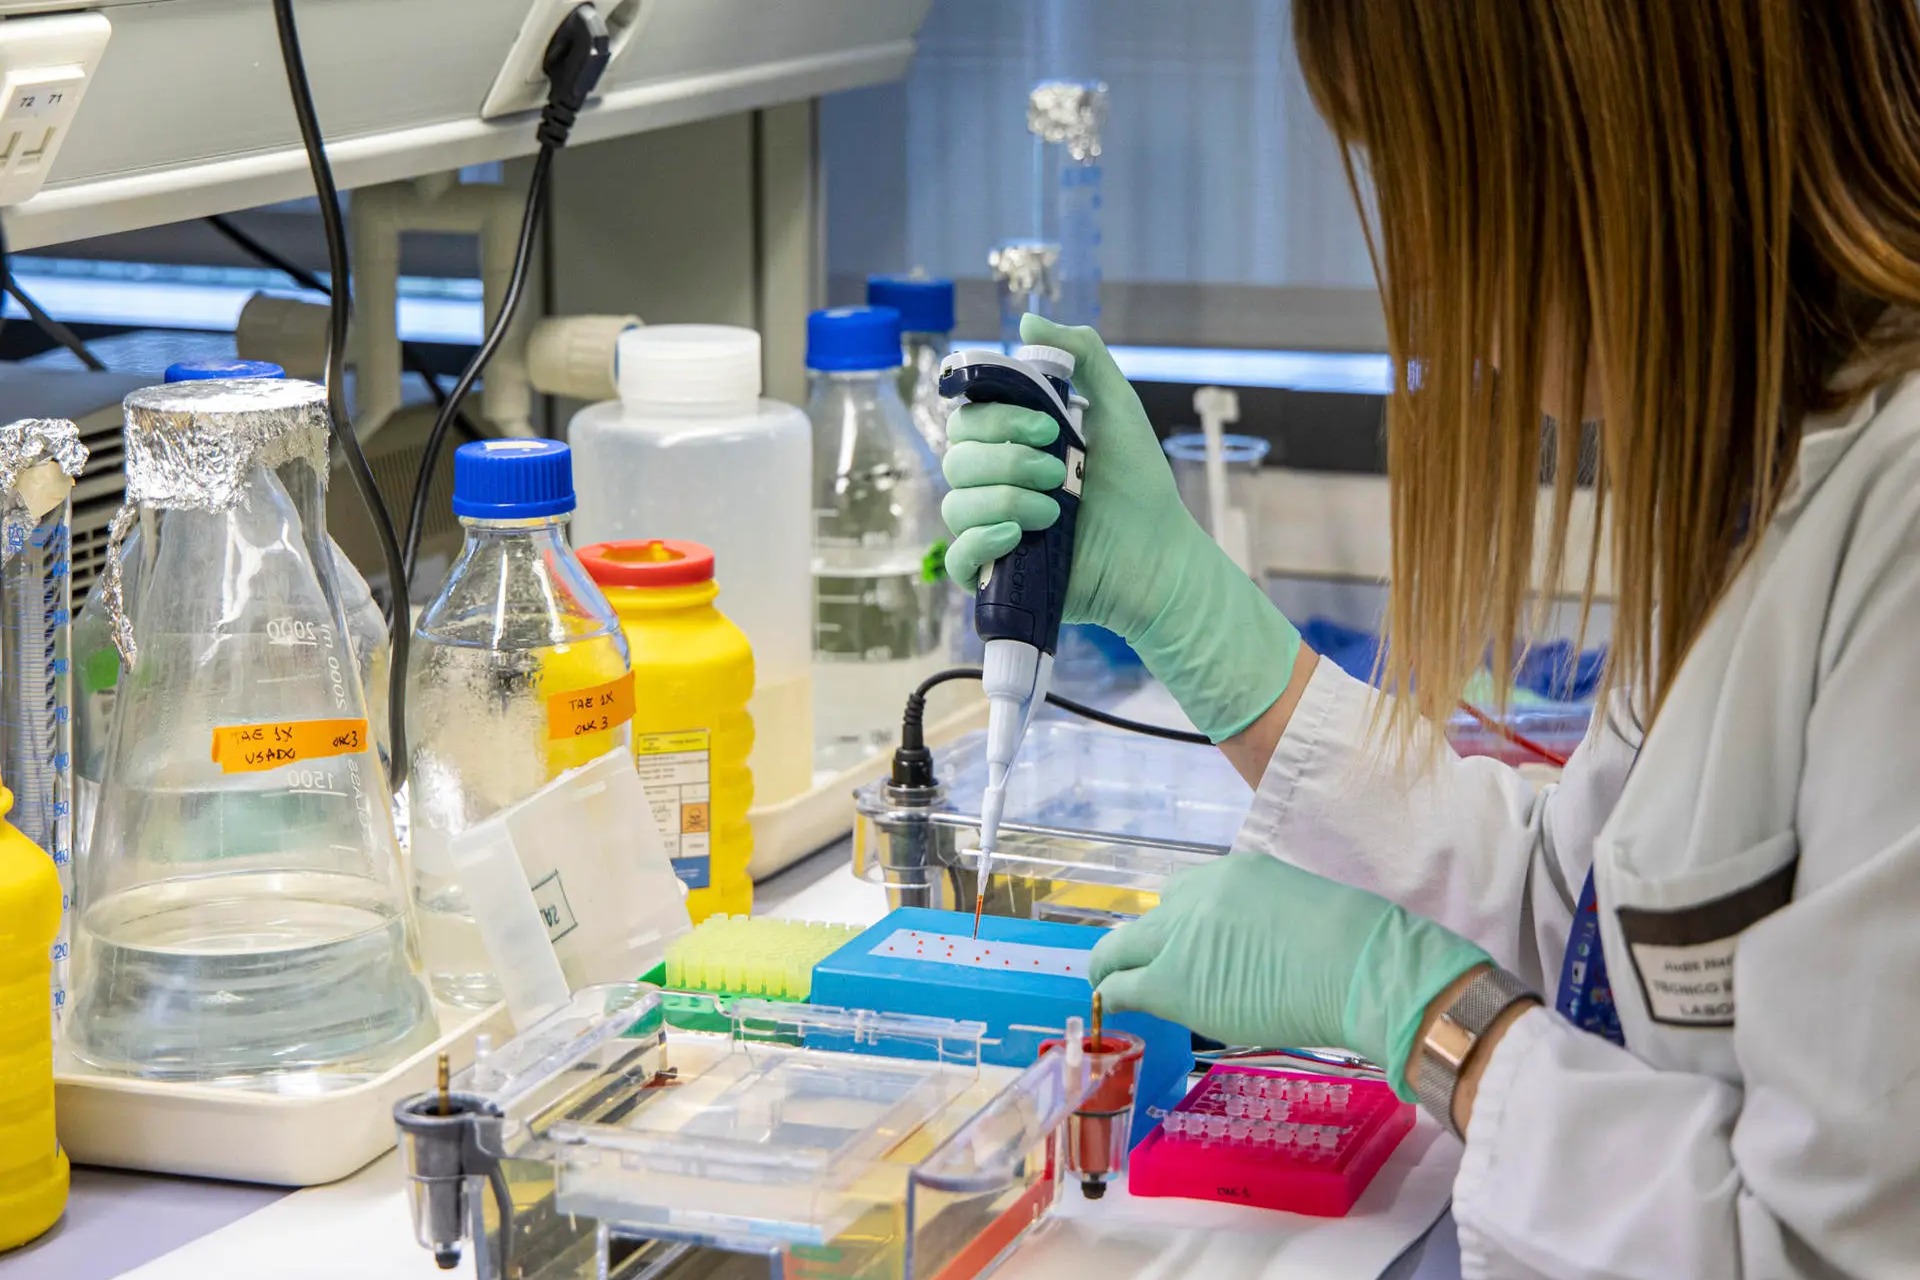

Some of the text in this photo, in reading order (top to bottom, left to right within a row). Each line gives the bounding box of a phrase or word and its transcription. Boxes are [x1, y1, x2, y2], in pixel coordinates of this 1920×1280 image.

[567, 697, 594, 712] TAE
[600, 715, 609, 731] 3
[230, 728, 265, 746] TAE
[351, 730, 359, 748] 3
[244, 747, 296, 765] USADO
[53, 943, 69, 960] 20
[53, 990, 66, 1006] 10
